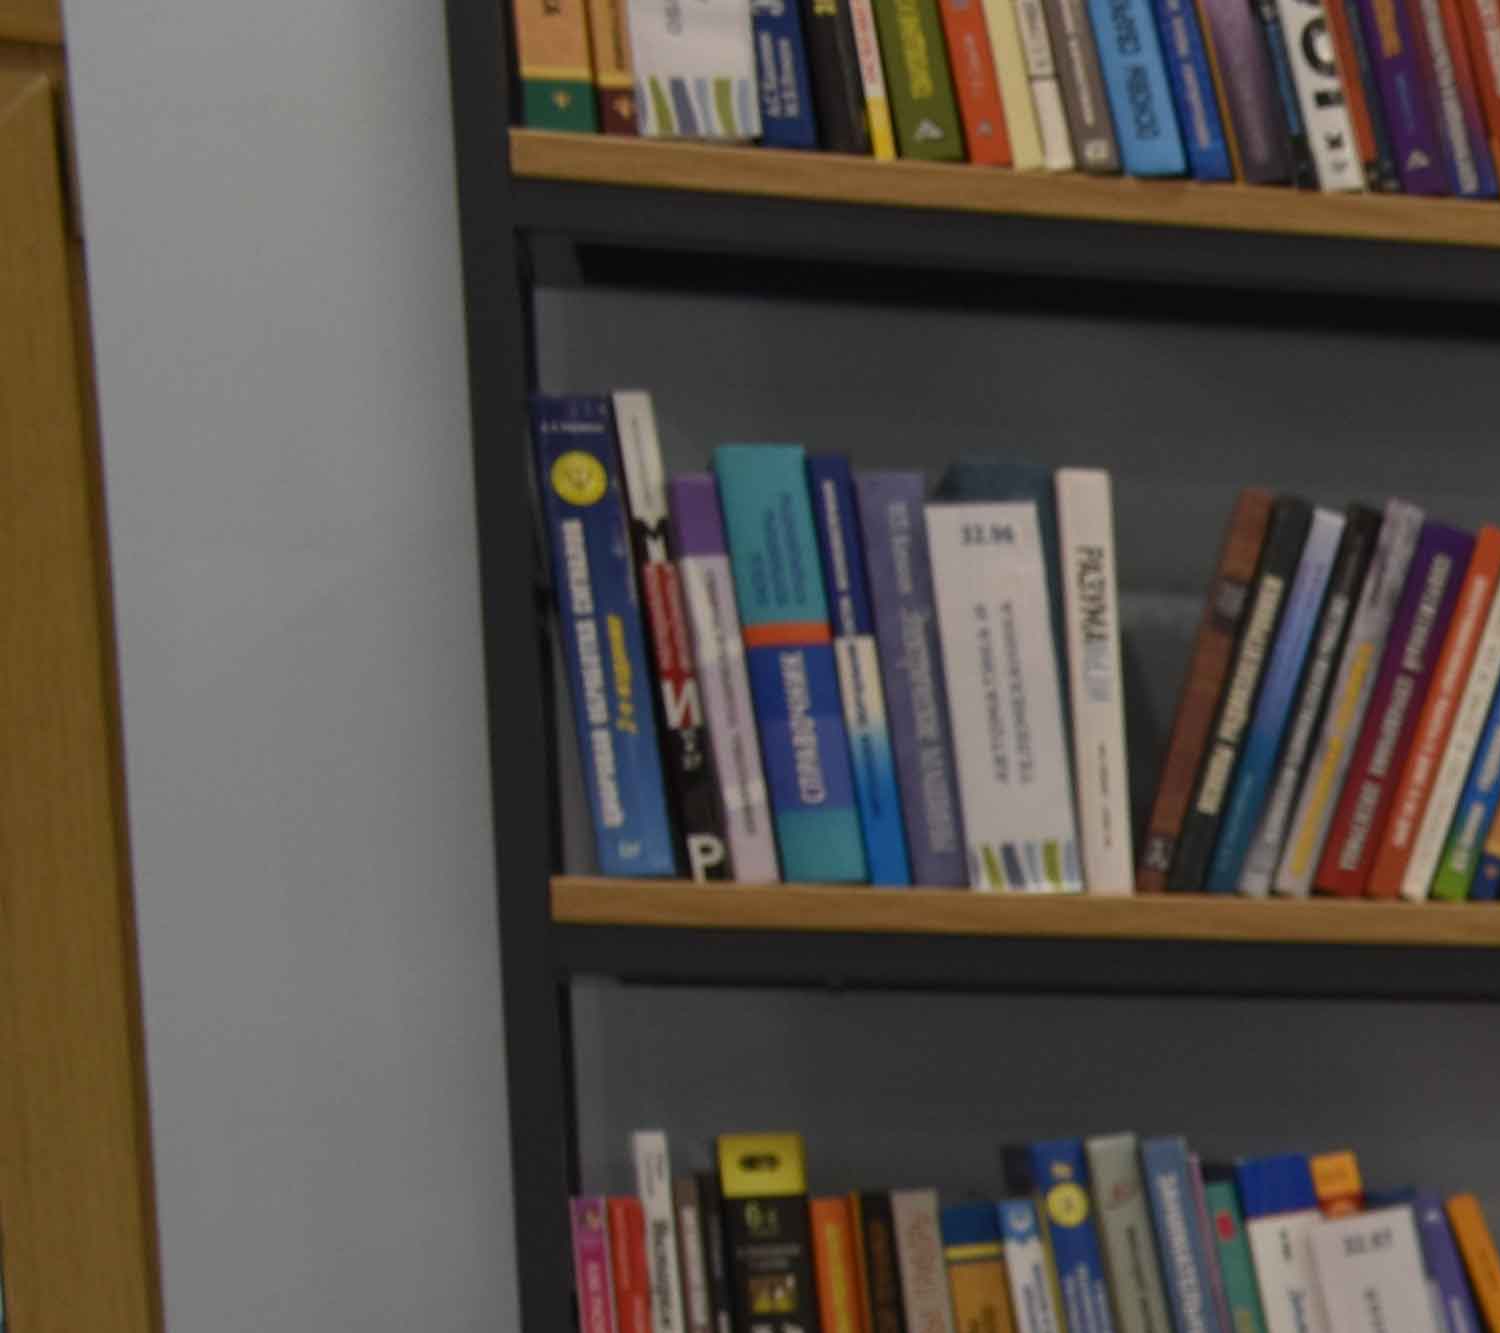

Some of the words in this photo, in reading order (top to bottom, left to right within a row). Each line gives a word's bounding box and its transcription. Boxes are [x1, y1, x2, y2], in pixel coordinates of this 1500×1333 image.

[561, 518, 595, 614] СИГНАЛОВ
[575, 619, 610, 723] ОБРАБОТКА
[778, 649, 825, 806] СПРАВОЧНИК
[977, 627, 1008, 783] АВТОМАТИКА
[999, 600, 1032, 783] ТЕЛЕМЕХАНИКА
